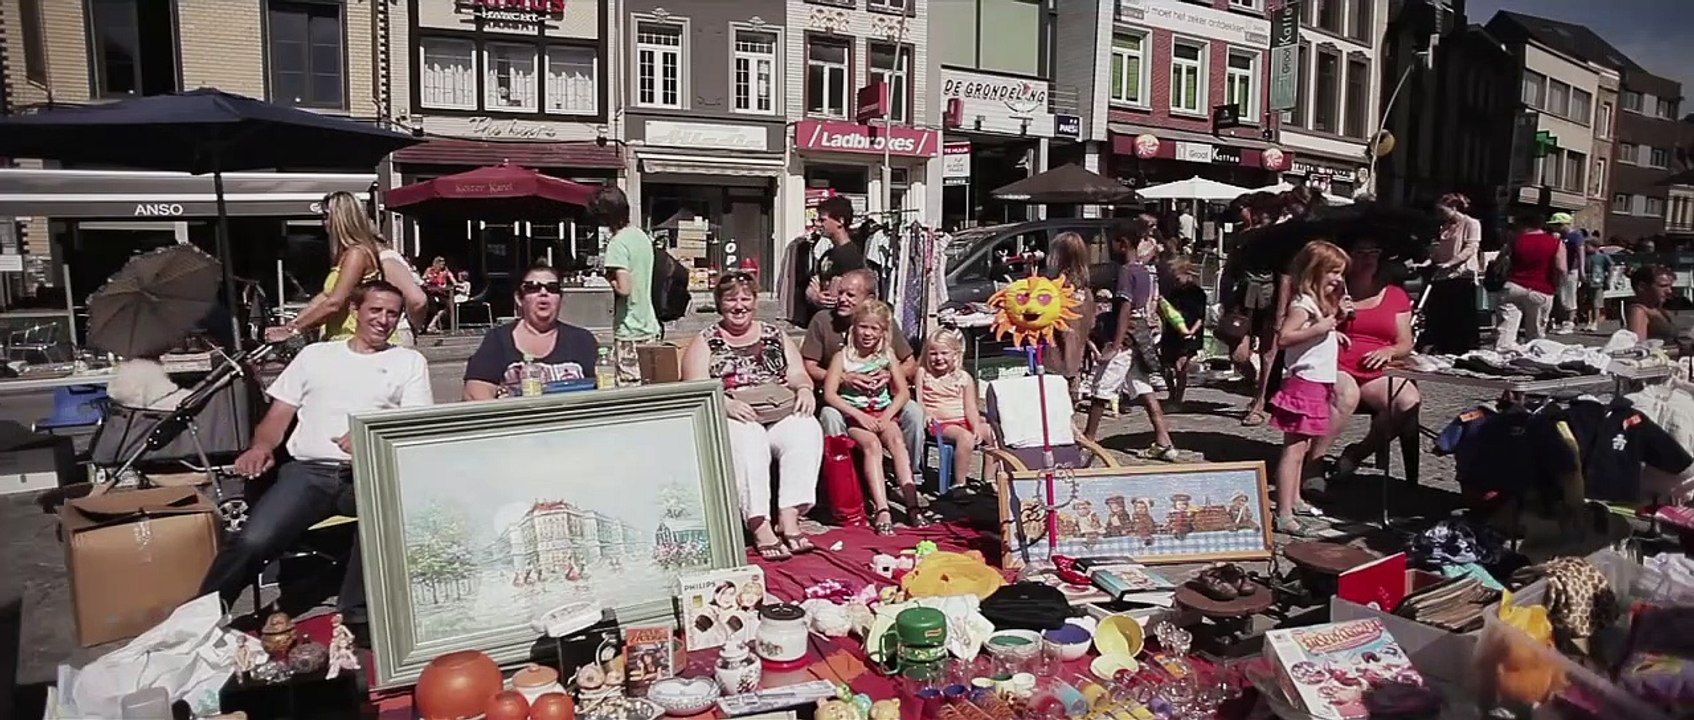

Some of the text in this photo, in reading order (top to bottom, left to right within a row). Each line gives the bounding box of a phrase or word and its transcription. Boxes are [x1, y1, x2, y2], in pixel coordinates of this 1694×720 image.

[944, 79, 963, 95] DE
[821, 131, 915, 152] Ladbrokes
[134, 203, 183, 216] ANSO
[684, 581, 716, 591] PHILIPS
